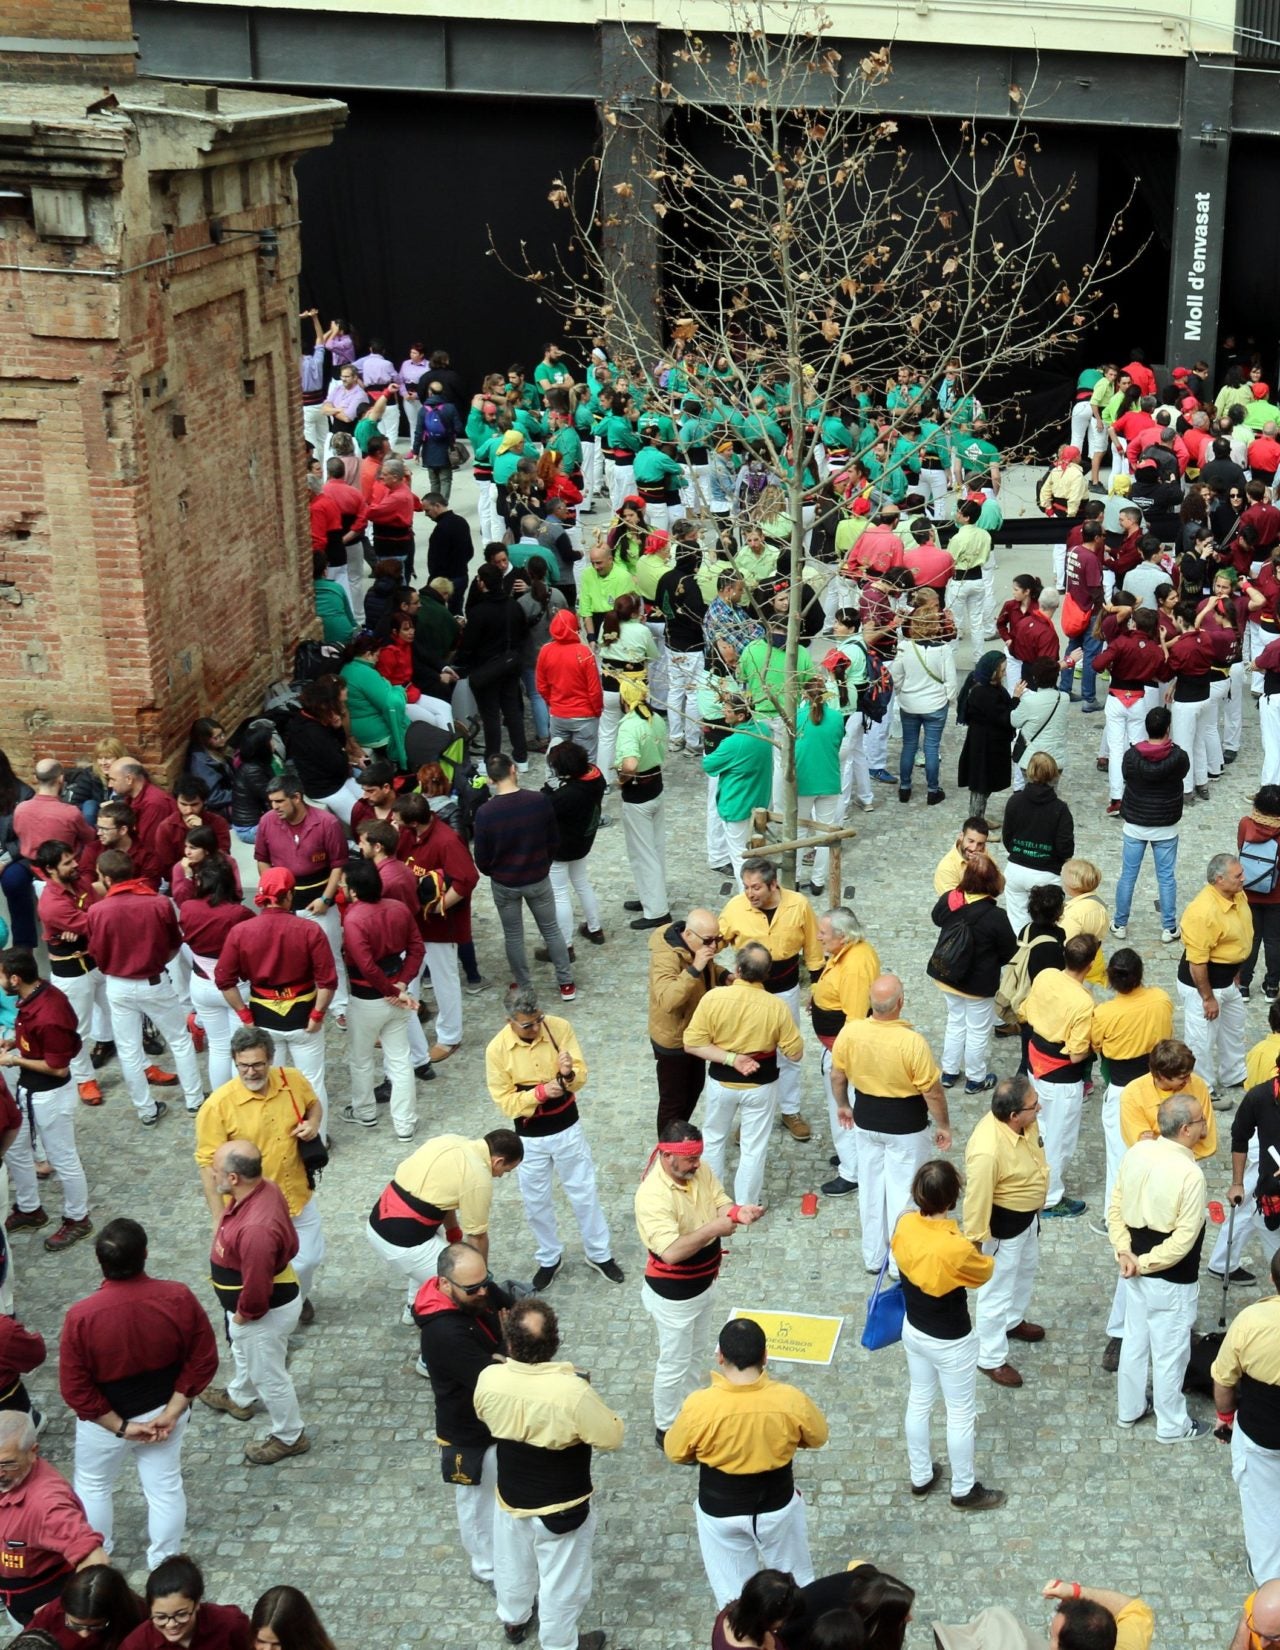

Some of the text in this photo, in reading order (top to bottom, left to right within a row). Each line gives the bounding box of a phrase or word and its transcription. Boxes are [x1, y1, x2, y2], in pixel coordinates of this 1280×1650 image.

[1184, 192, 1211, 341] Moll d'envasat
[766, 1337, 813, 1347] DEGASSOS
